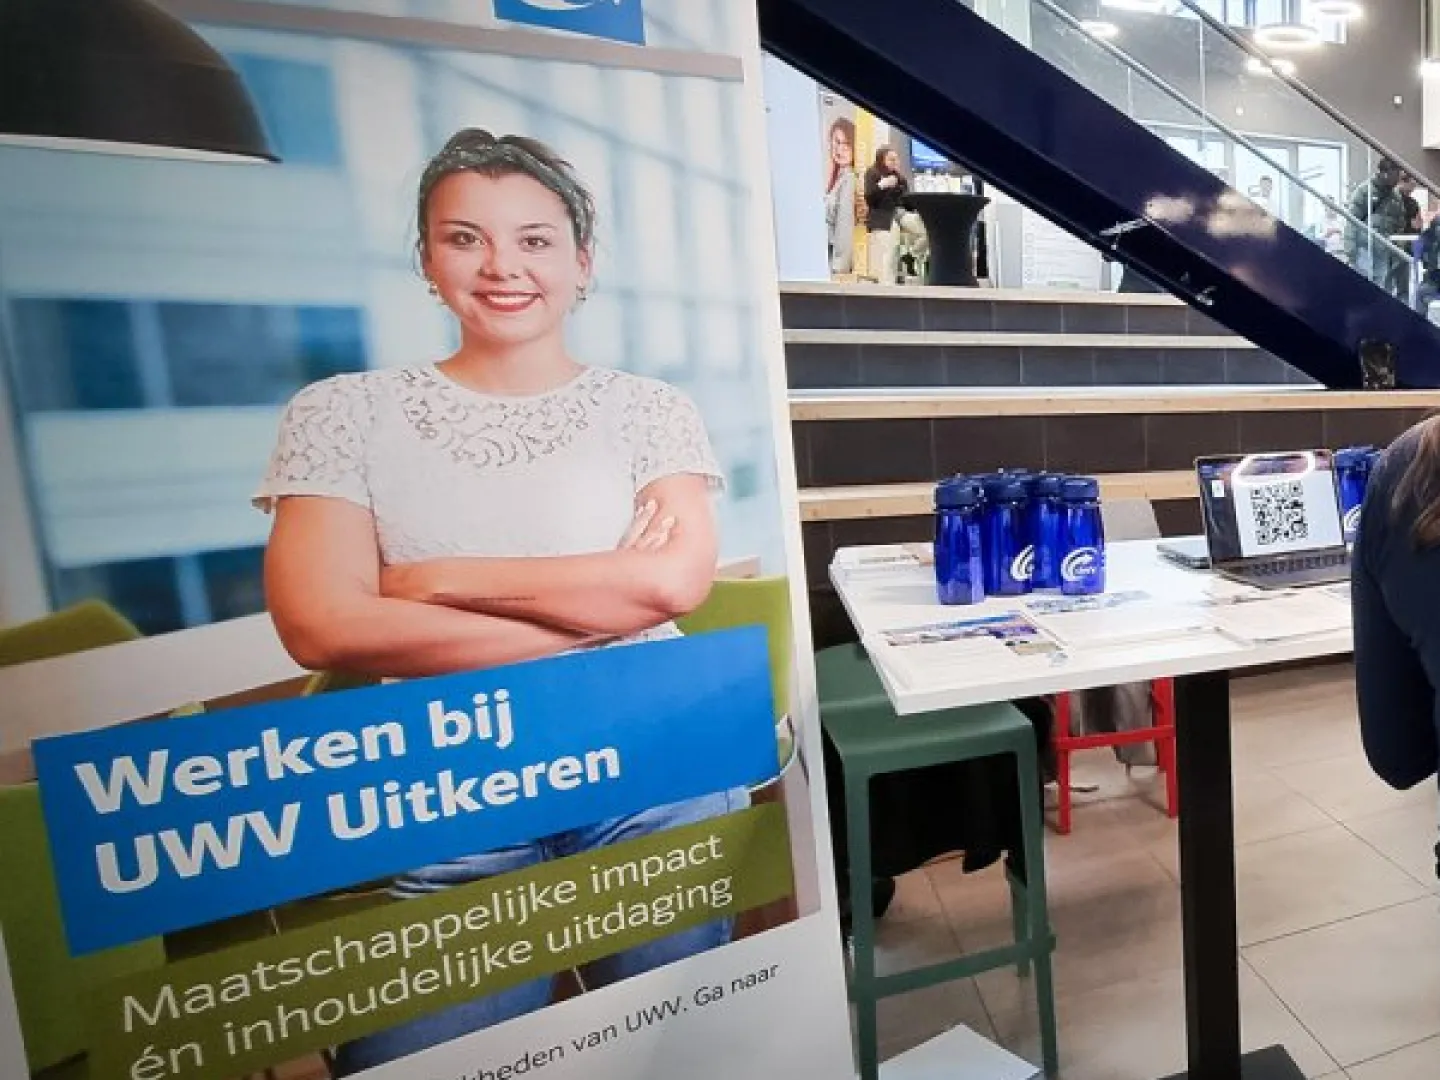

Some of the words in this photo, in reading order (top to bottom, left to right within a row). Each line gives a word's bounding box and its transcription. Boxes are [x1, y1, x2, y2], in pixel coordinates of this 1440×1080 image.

[74, 721, 406, 814] Werken
[427, 688, 515, 749] bij
[96, 802, 301, 894] UWV
[327, 747, 621, 840] Uitkeren
[122, 880, 578, 1033] Maatschappelijke
[589, 834, 723, 894] impact
[130, 1041, 205, 1080] én
[223, 940, 533, 1055] inhoudelijke
[546, 875, 733, 953] uitdaging
[571, 1023, 618, 1052] van
[625, 996, 688, 1033] UWV.
[693, 985, 724, 1007] Ga
[731, 963, 780, 994] naar
